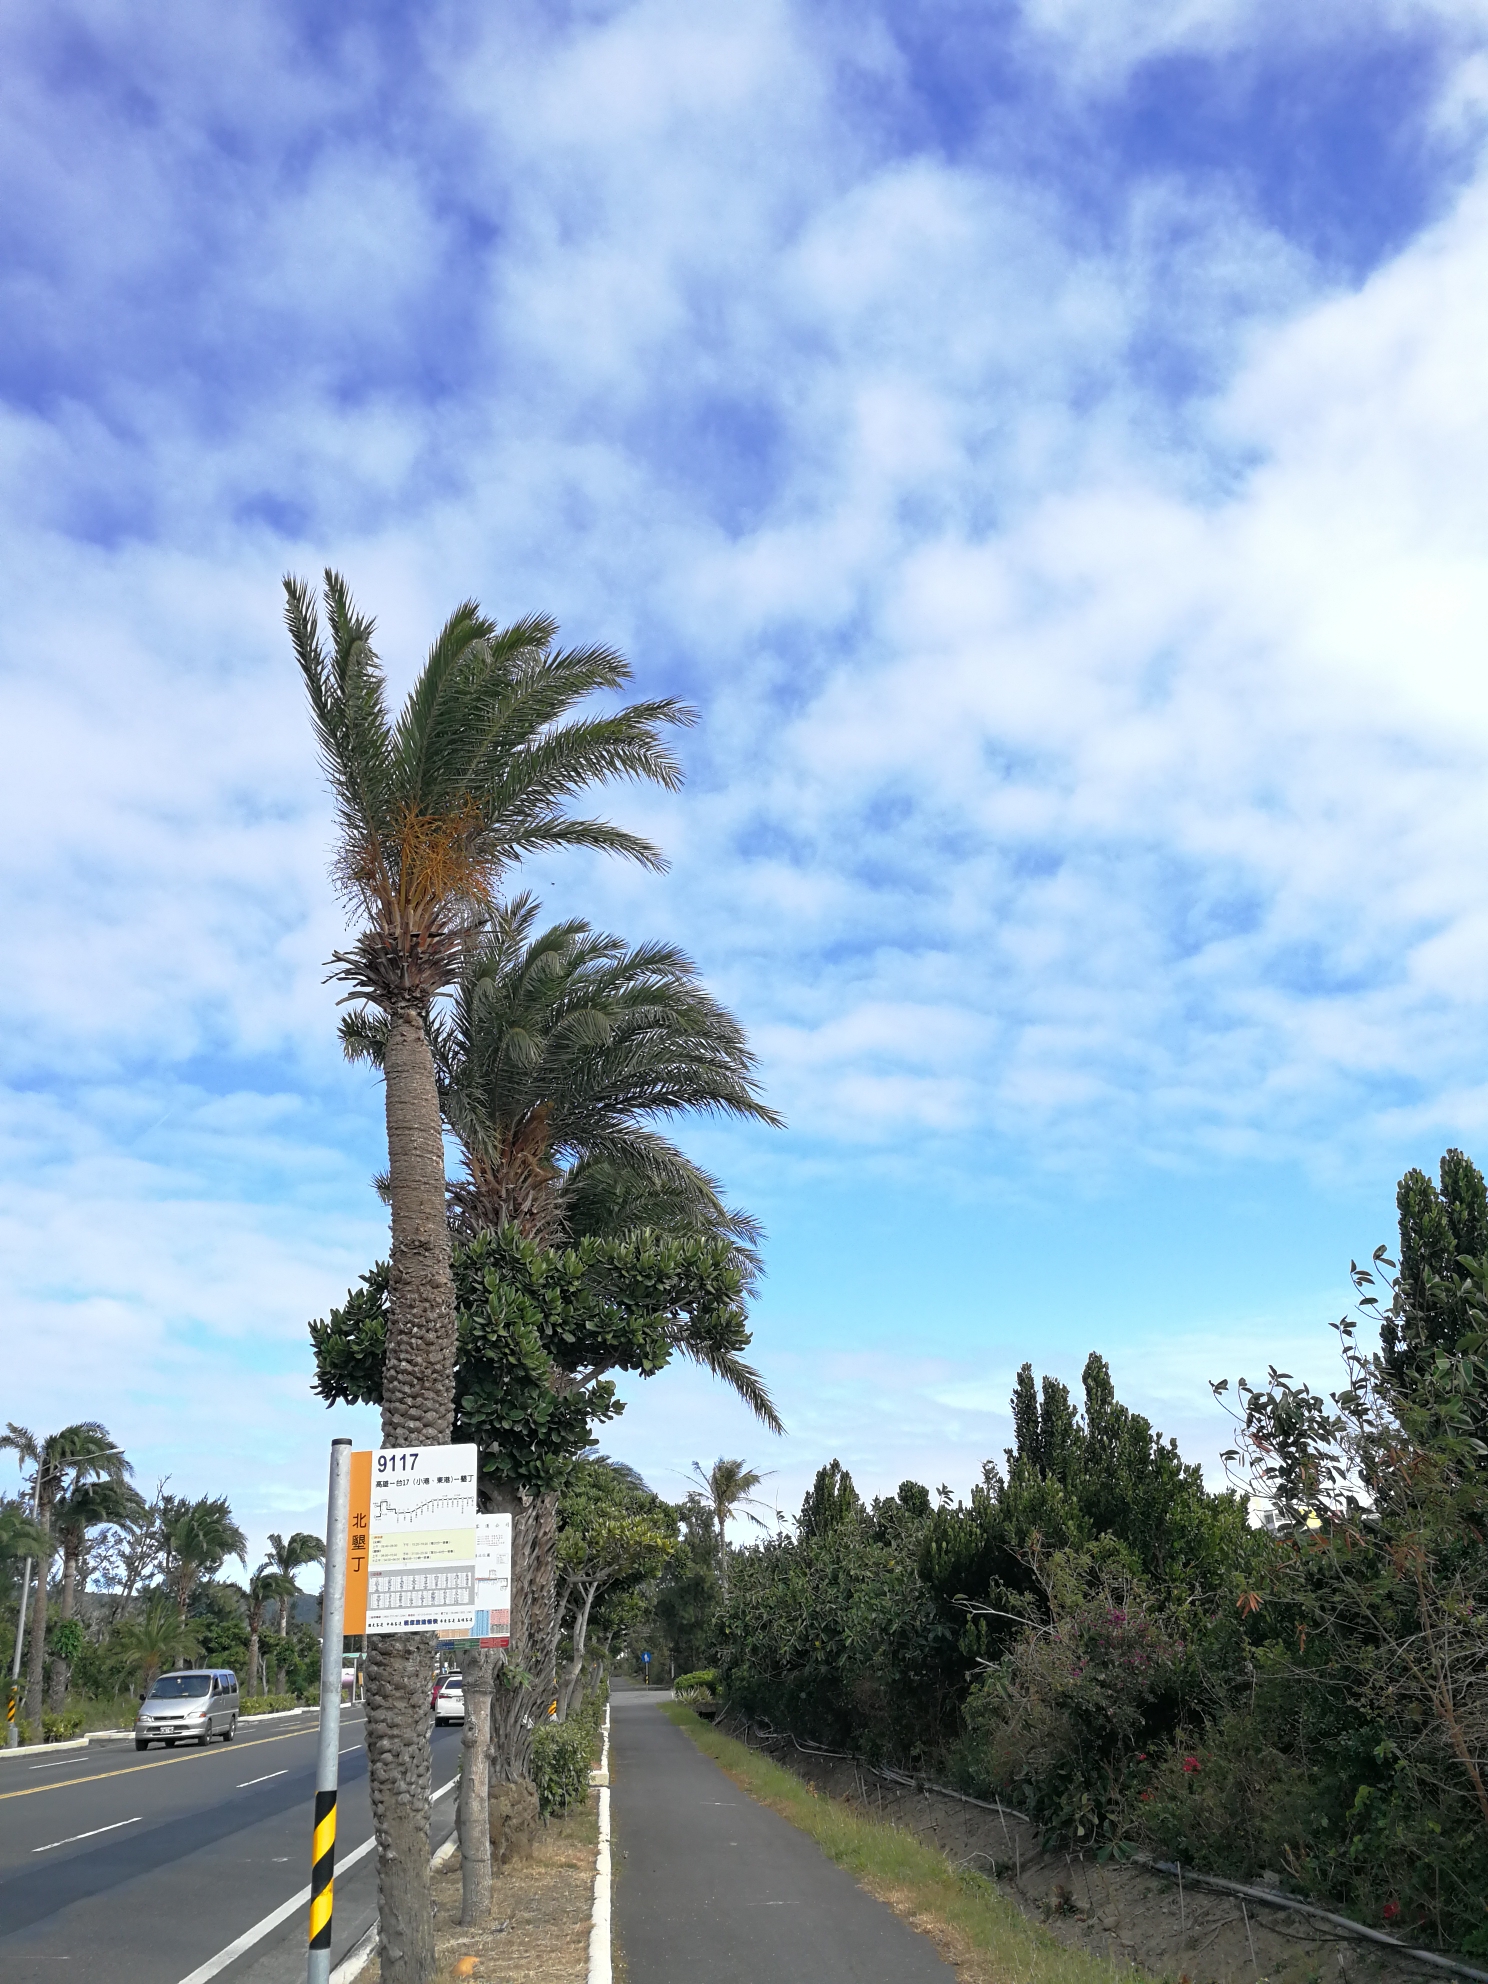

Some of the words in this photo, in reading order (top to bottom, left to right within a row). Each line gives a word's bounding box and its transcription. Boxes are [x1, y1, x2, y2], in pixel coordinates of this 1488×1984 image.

[377, 1453, 419, 1472] 9117
[351, 1513, 367, 1572] 北墾丁
